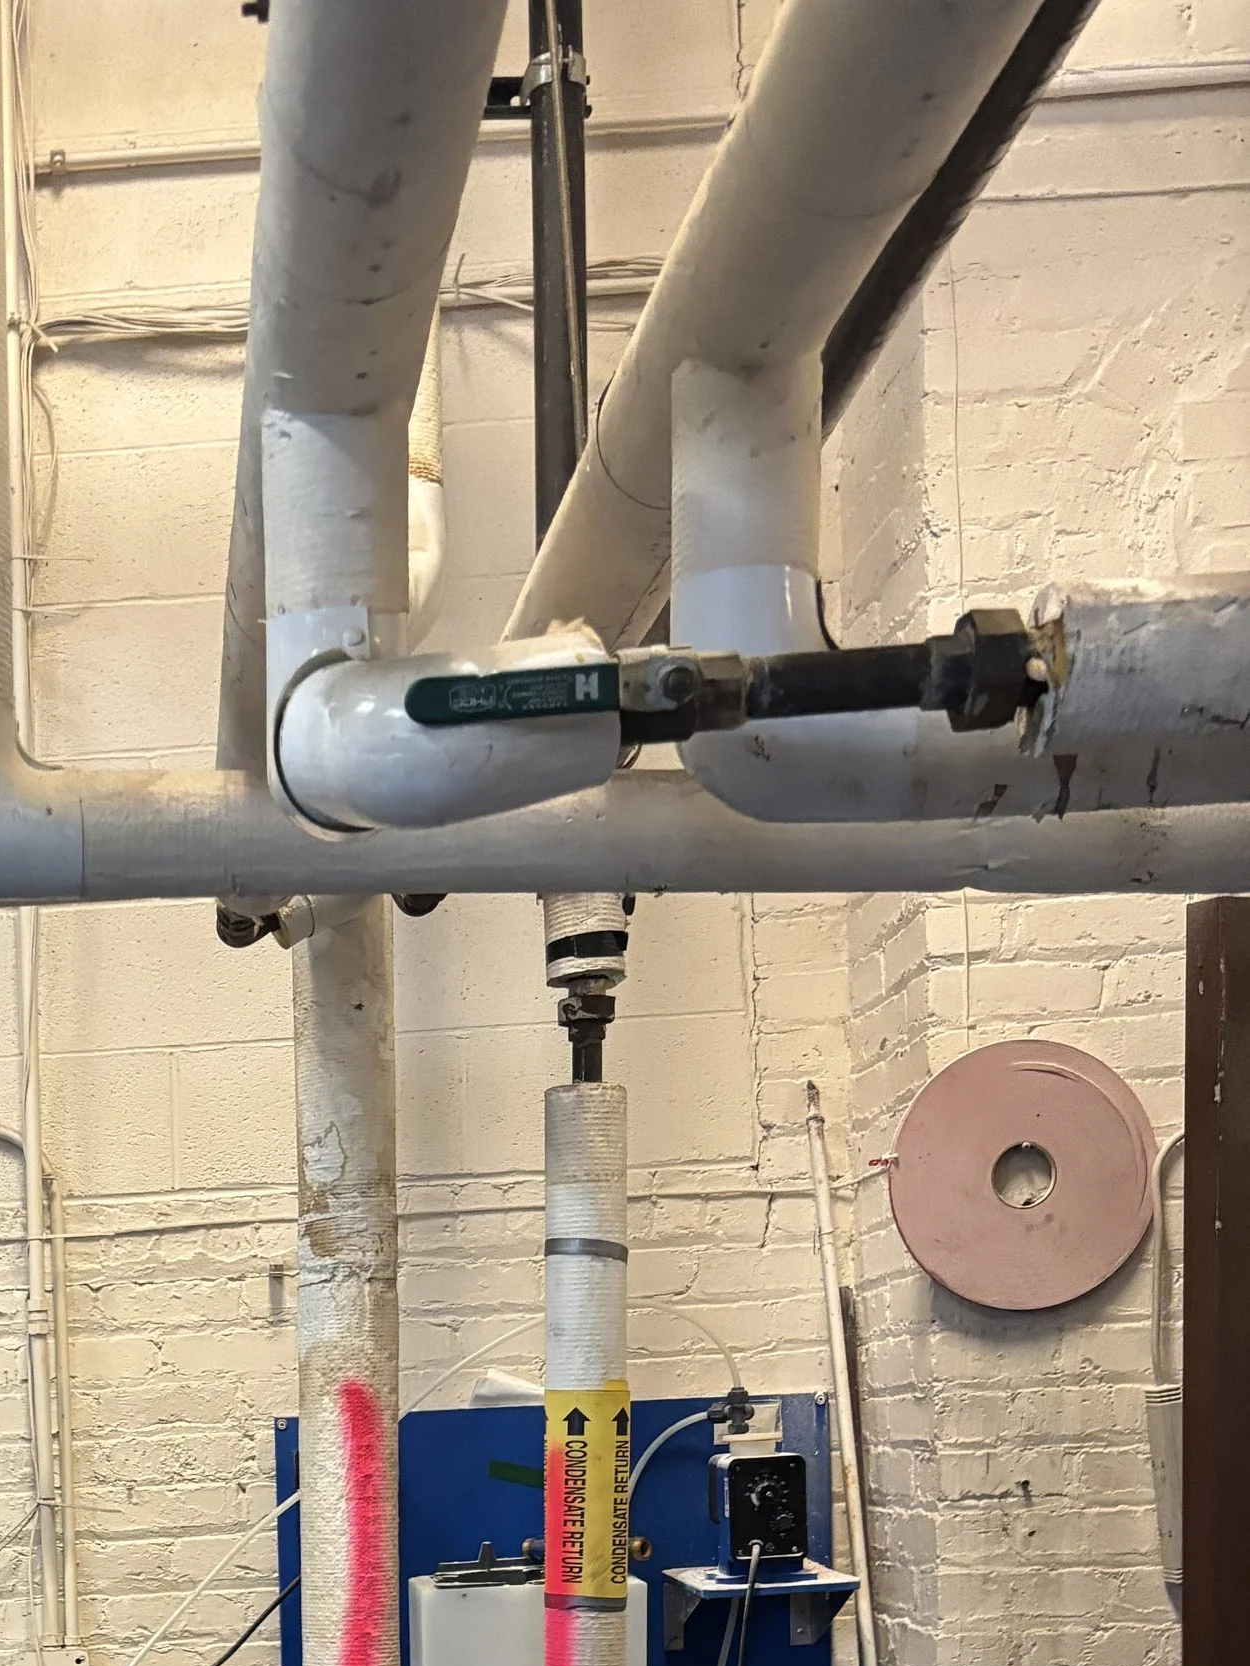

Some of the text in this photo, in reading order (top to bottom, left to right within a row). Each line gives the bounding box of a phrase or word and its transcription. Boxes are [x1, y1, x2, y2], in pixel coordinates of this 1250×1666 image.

[561, 1440, 588, 1584] CONDENSATE RETURN
[611, 1440, 630, 1584] CONDENSATE RETURN
